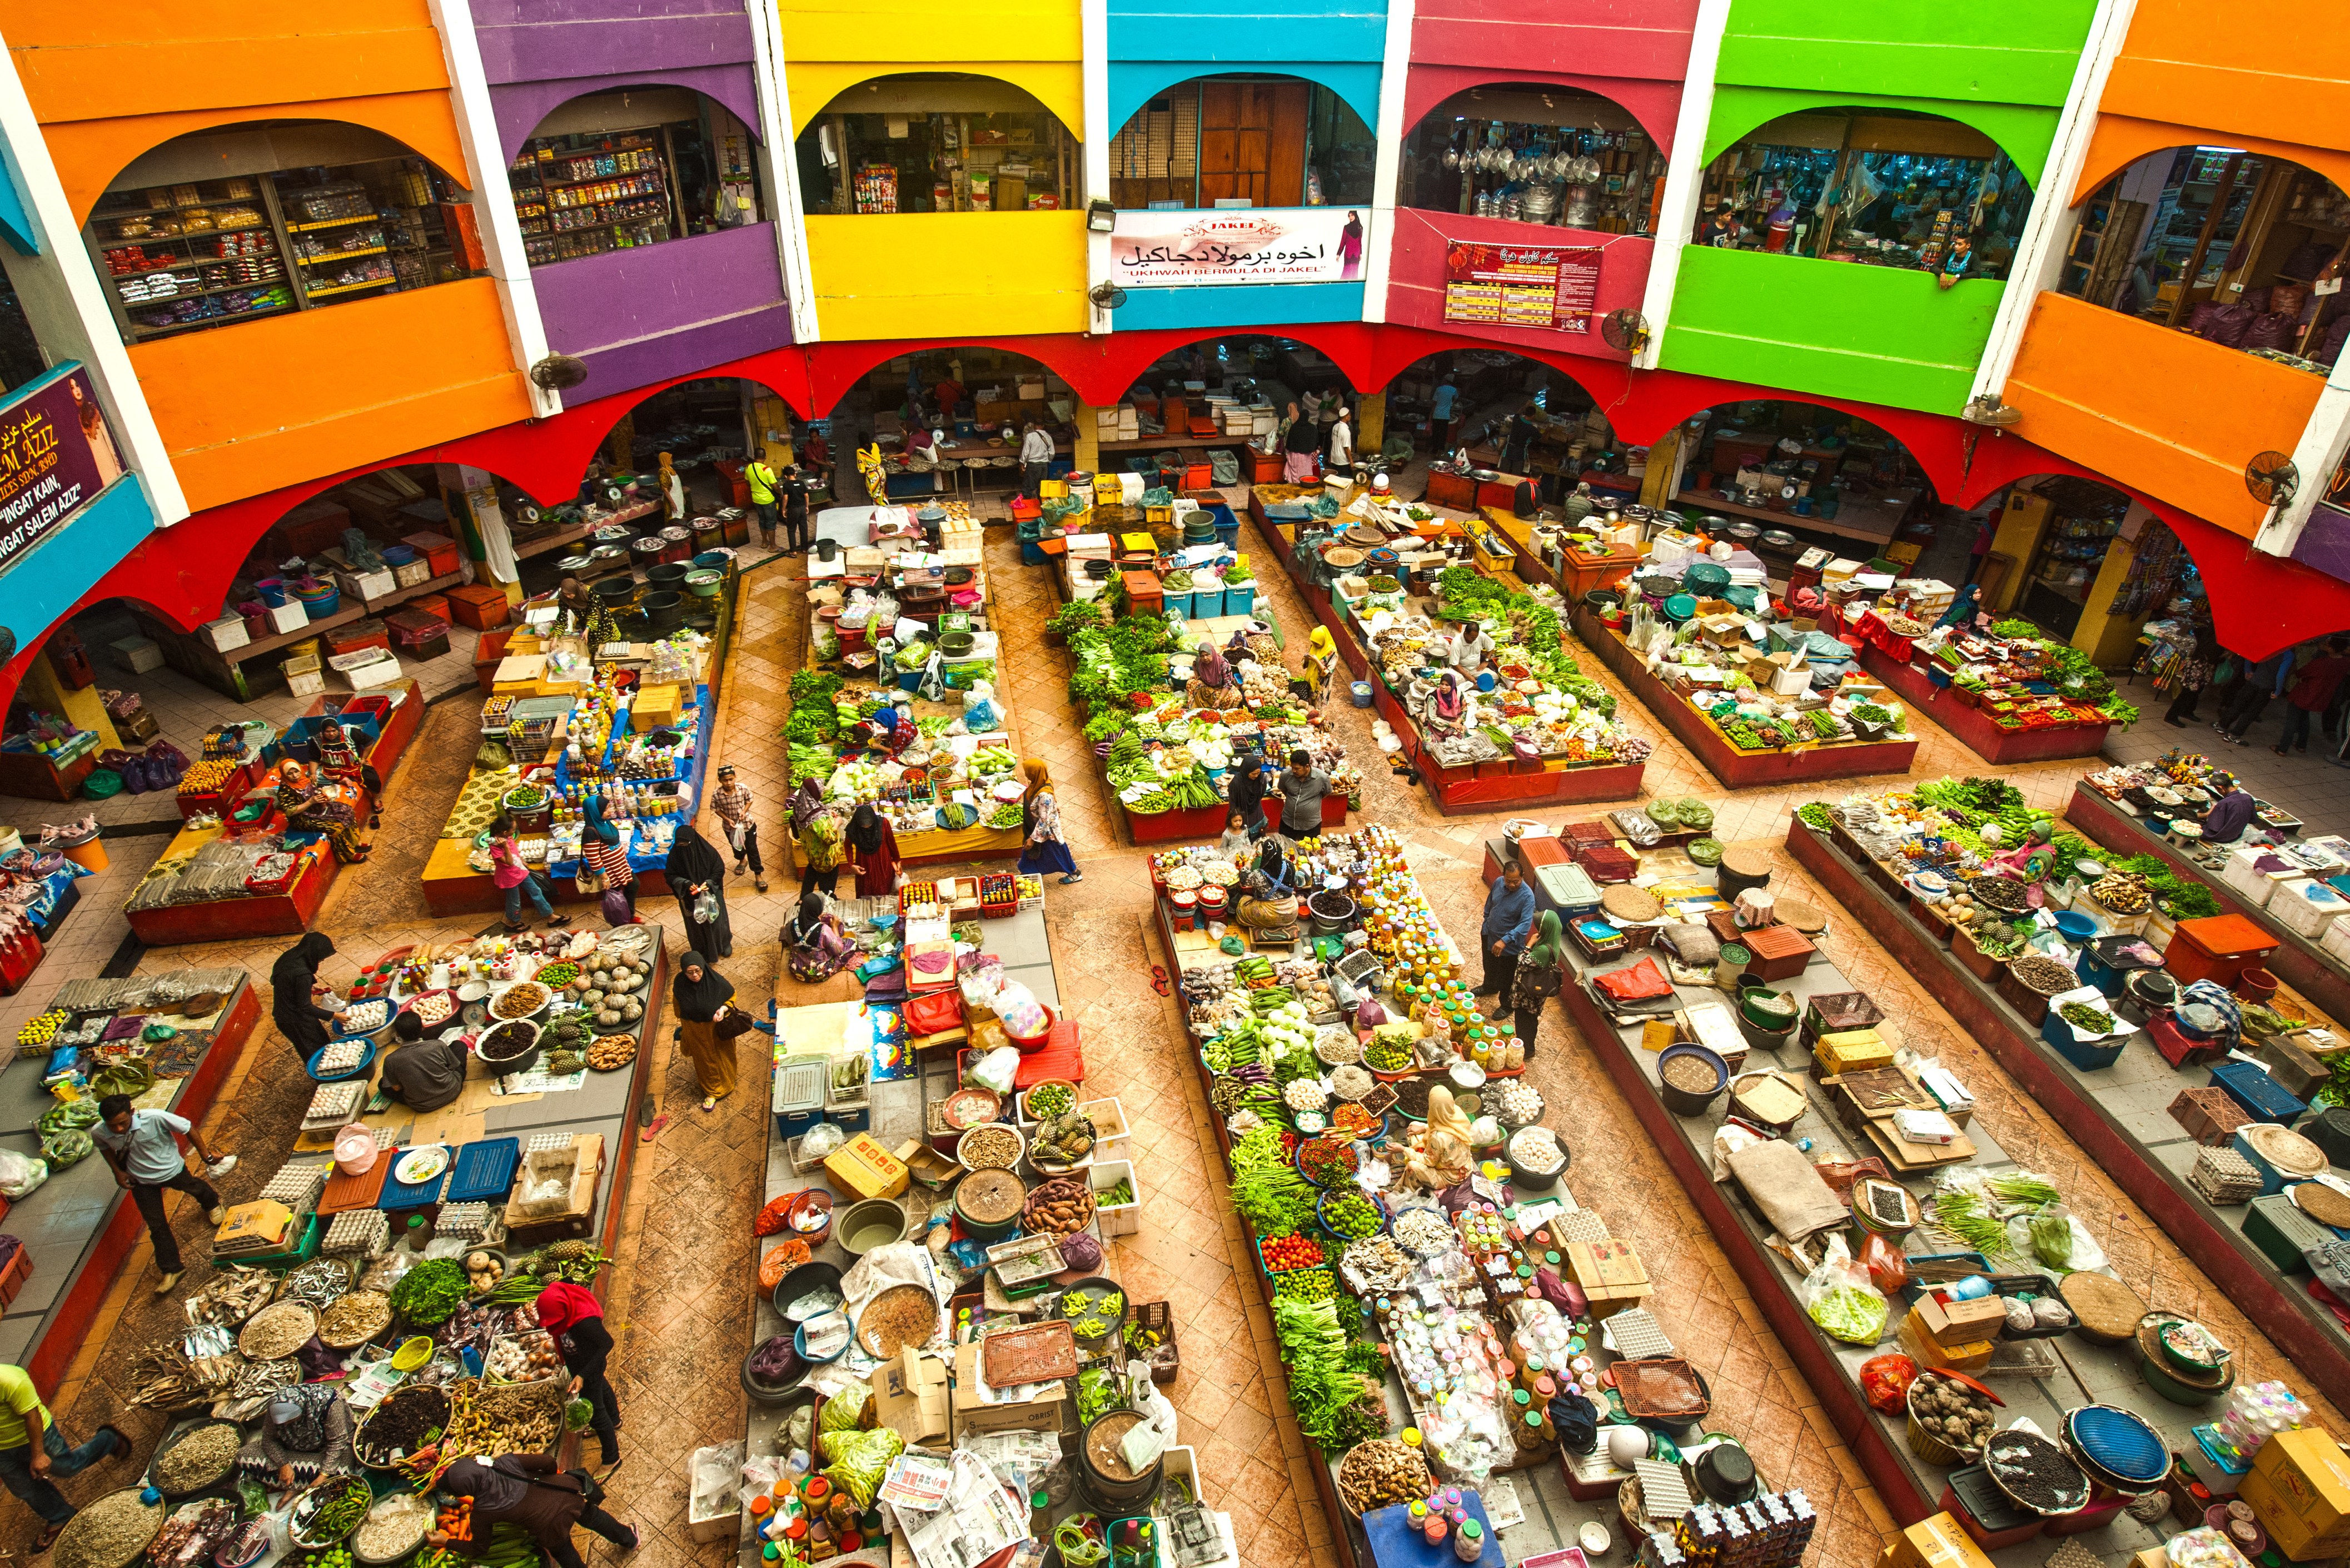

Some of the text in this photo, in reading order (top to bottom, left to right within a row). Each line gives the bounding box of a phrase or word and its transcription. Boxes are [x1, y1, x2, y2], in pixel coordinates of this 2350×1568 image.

[23, 424, 58, 464] AZIZ
[39, 452, 58, 472] BHD
[25, 502, 58, 536] SALEM
[1028, 1410, 1054, 1421] OBRIST
